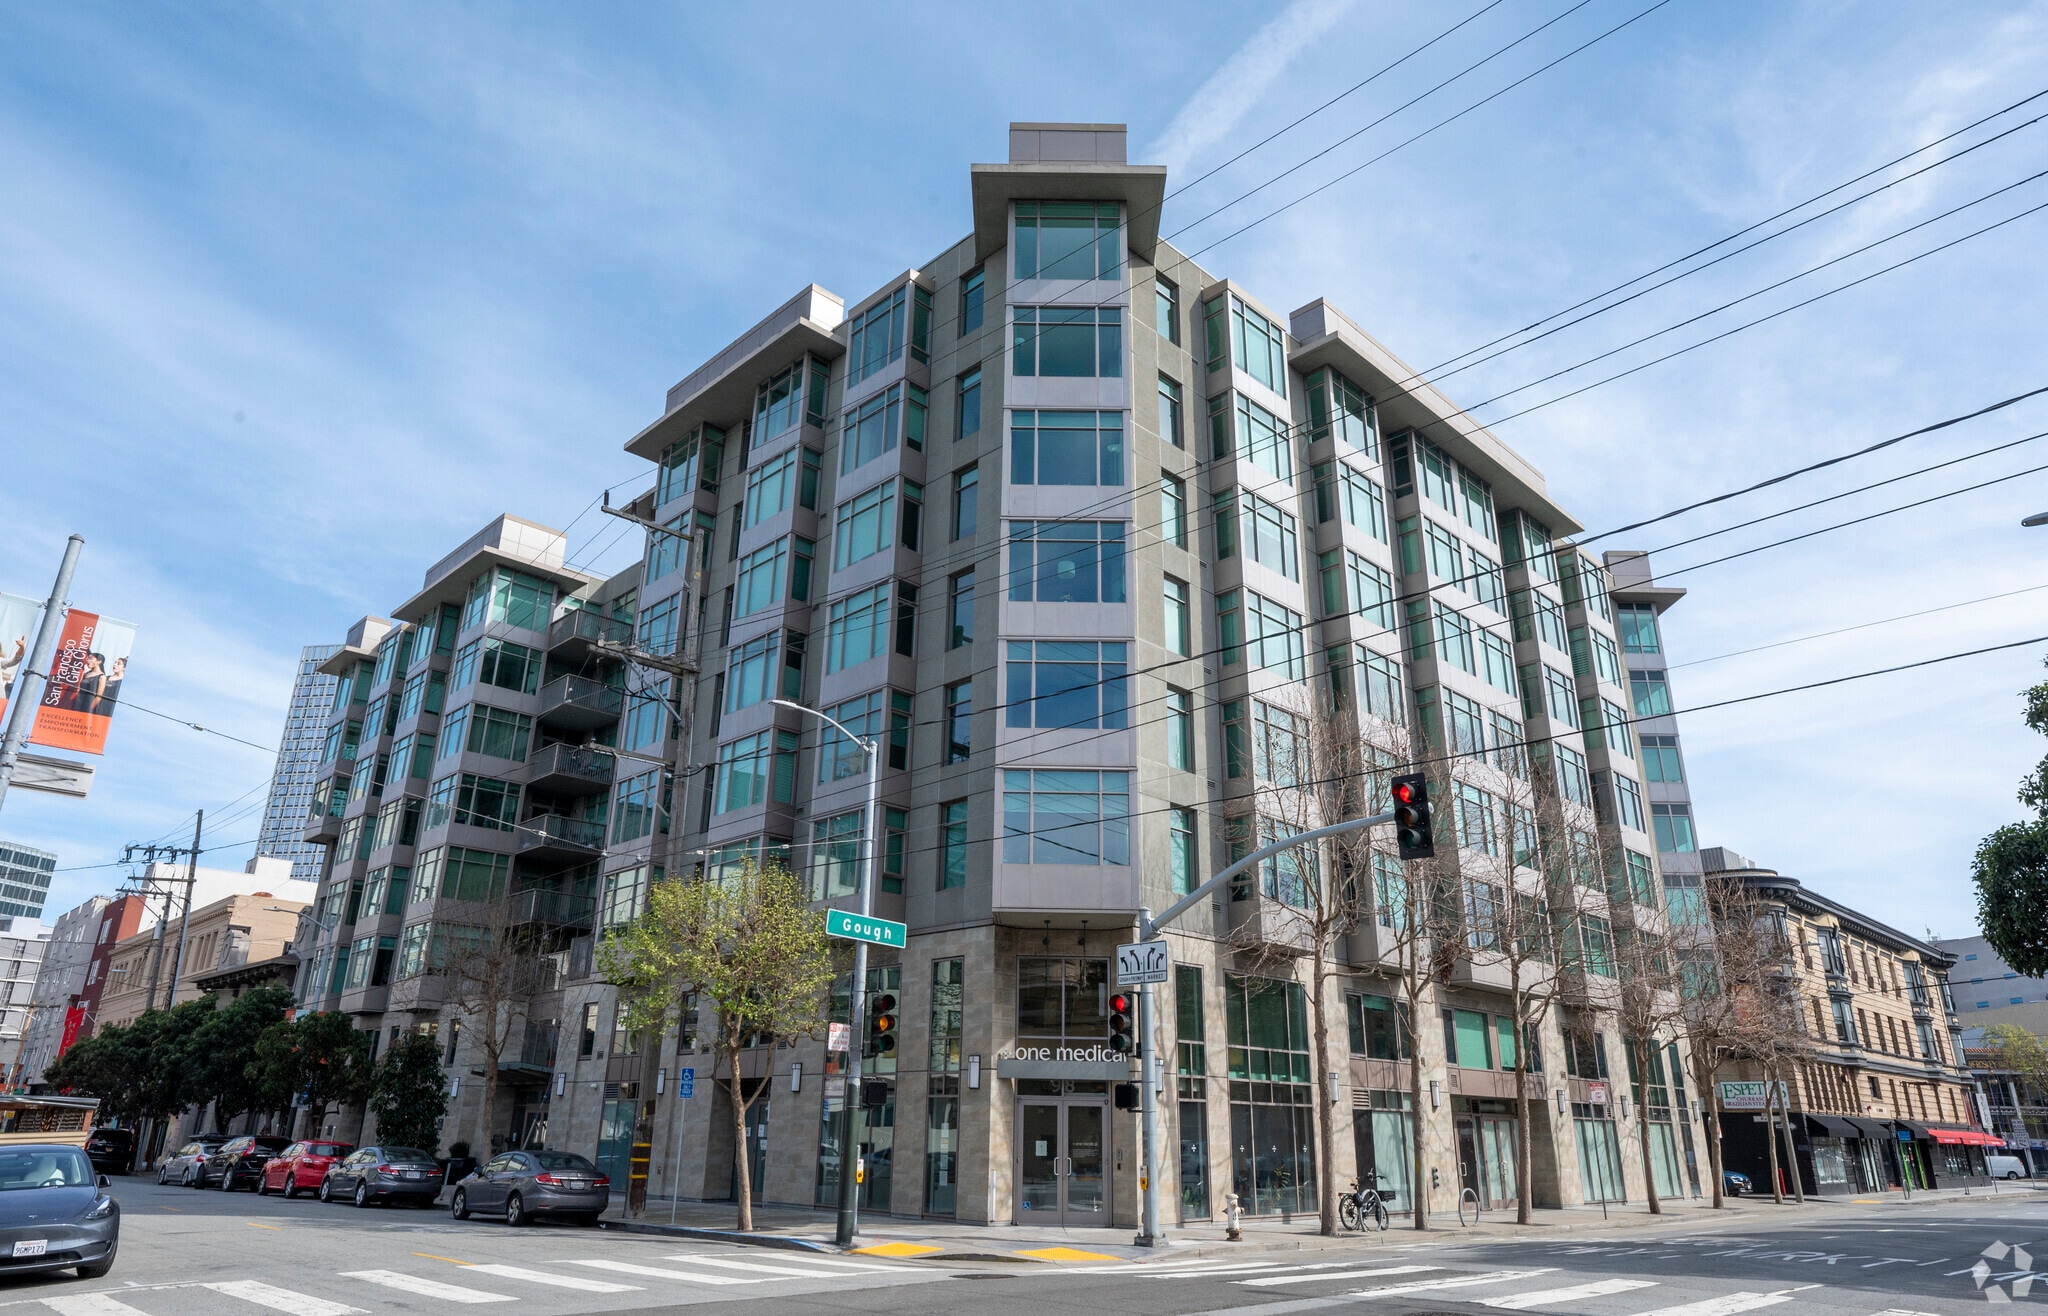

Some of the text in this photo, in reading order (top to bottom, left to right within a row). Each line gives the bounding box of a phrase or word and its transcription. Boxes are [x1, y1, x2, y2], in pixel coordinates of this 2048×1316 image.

[65, 626, 94, 683] Girls Chorus
[45, 639, 77, 706] San Francisco
[842, 918, 892, 941] Gough
[1015, 1046, 1051, 1061] one
[1722, 1083, 1787, 1099] ESPETS
